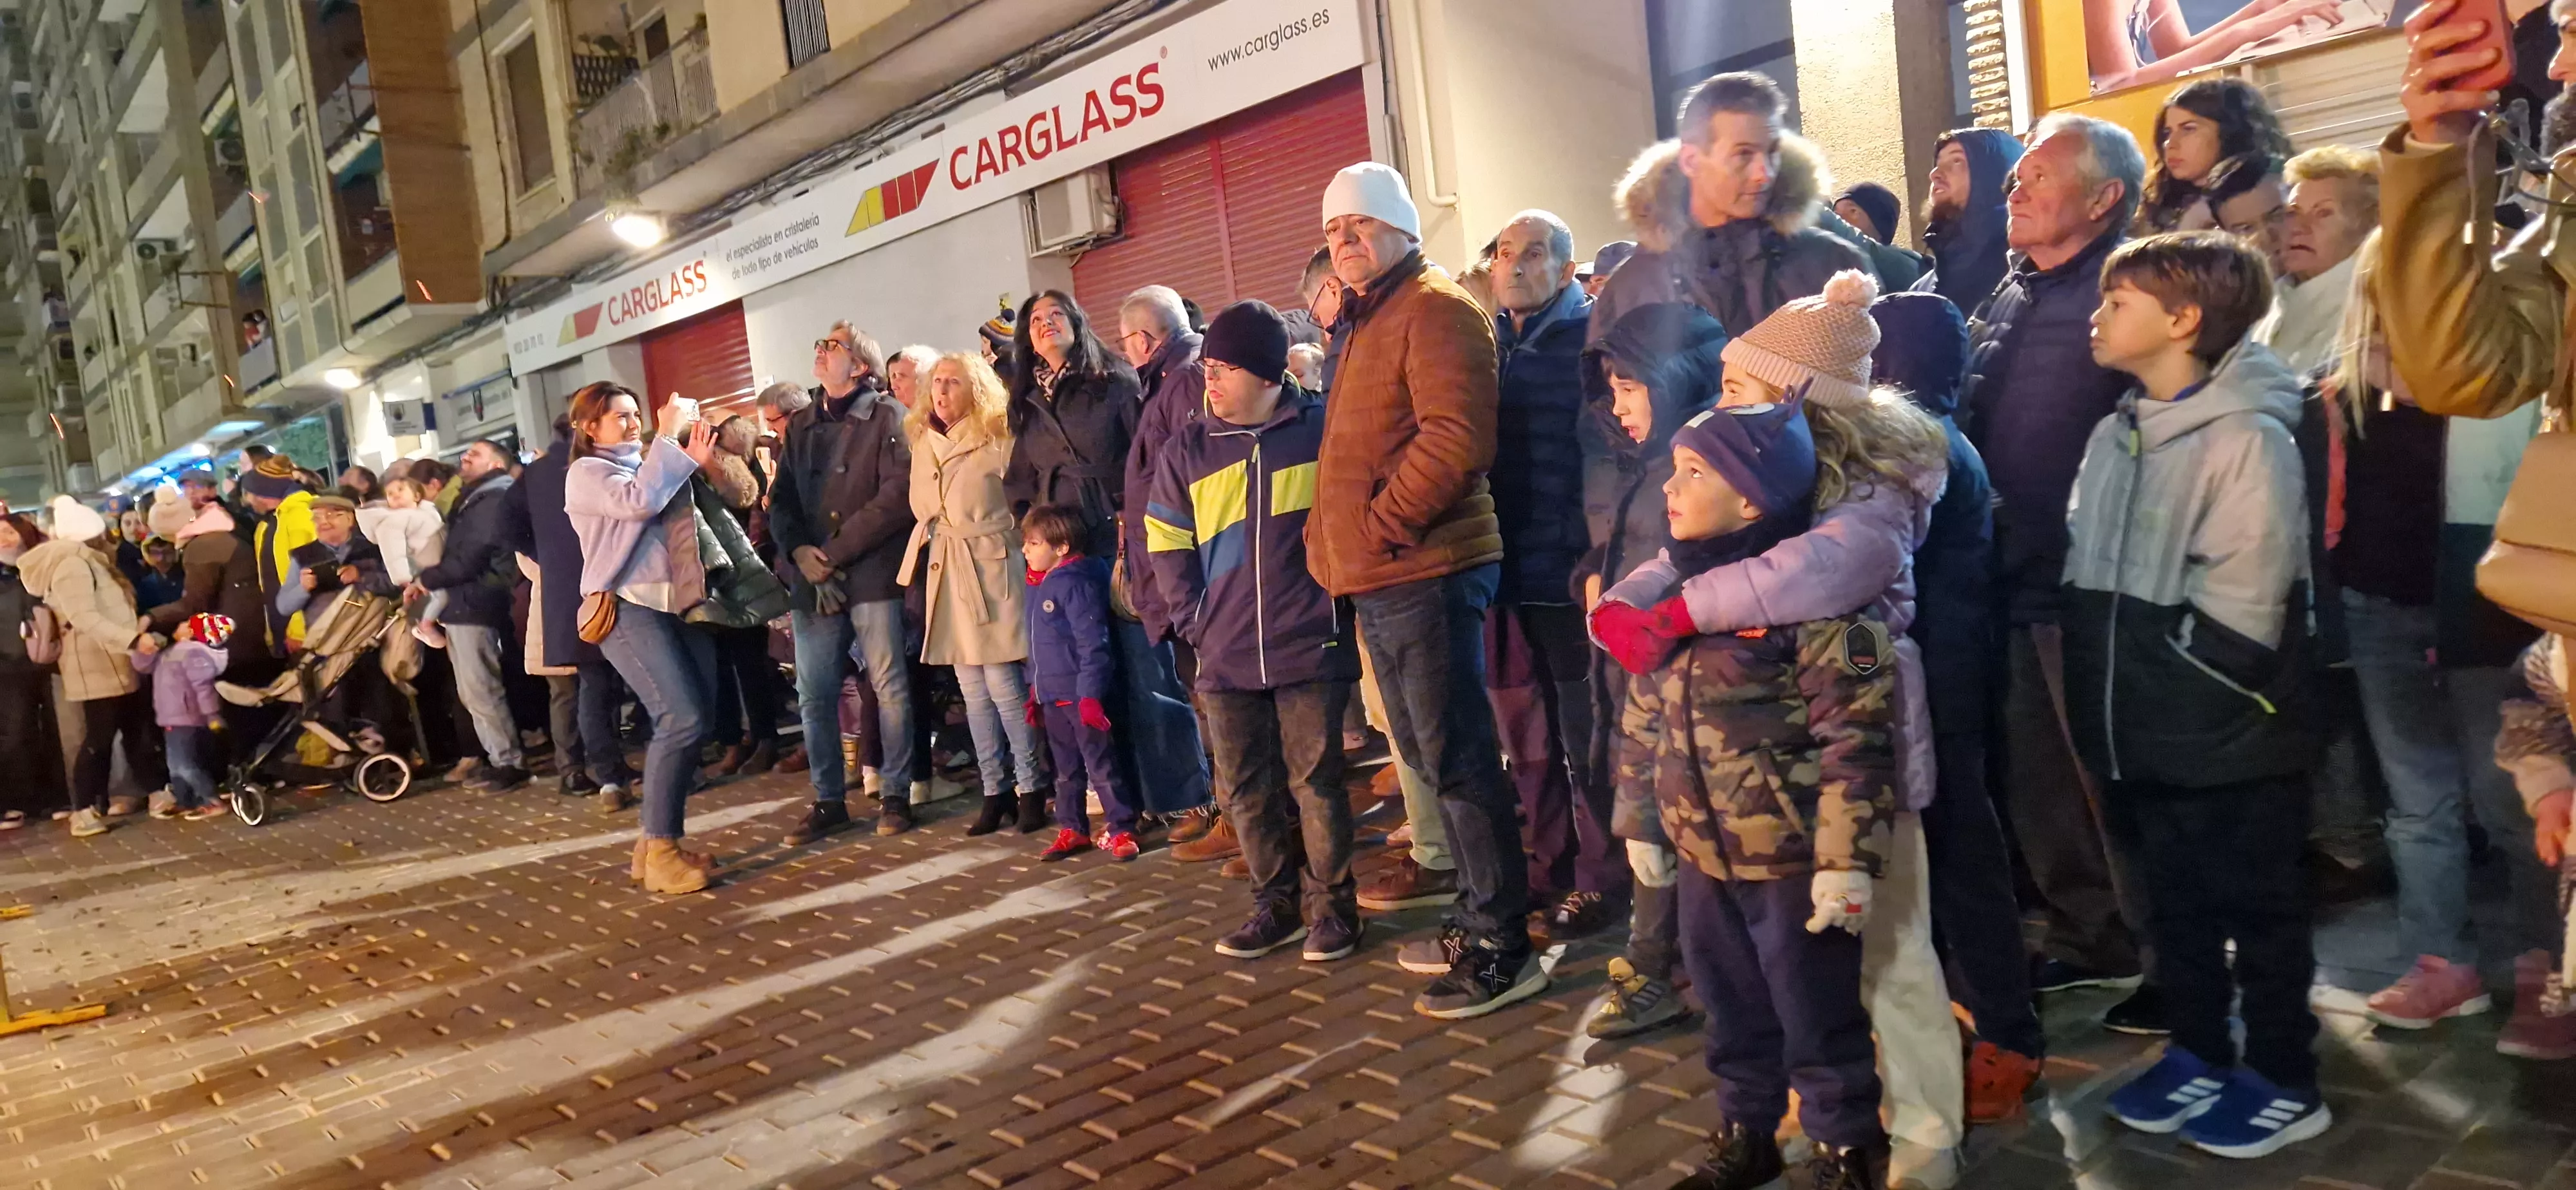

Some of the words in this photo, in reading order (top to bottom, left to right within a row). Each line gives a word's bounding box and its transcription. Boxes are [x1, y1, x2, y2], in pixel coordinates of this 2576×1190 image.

[1208, 8, 1330, 71] www.carglass.es
[949, 62, 1164, 190] CARGLASS
[726, 248, 732, 263] el
[733, 234, 773, 260] especialista
[773, 230, 783, 243] en
[773, 250, 782, 265] de
[608, 260, 707, 326] CARGLASS
